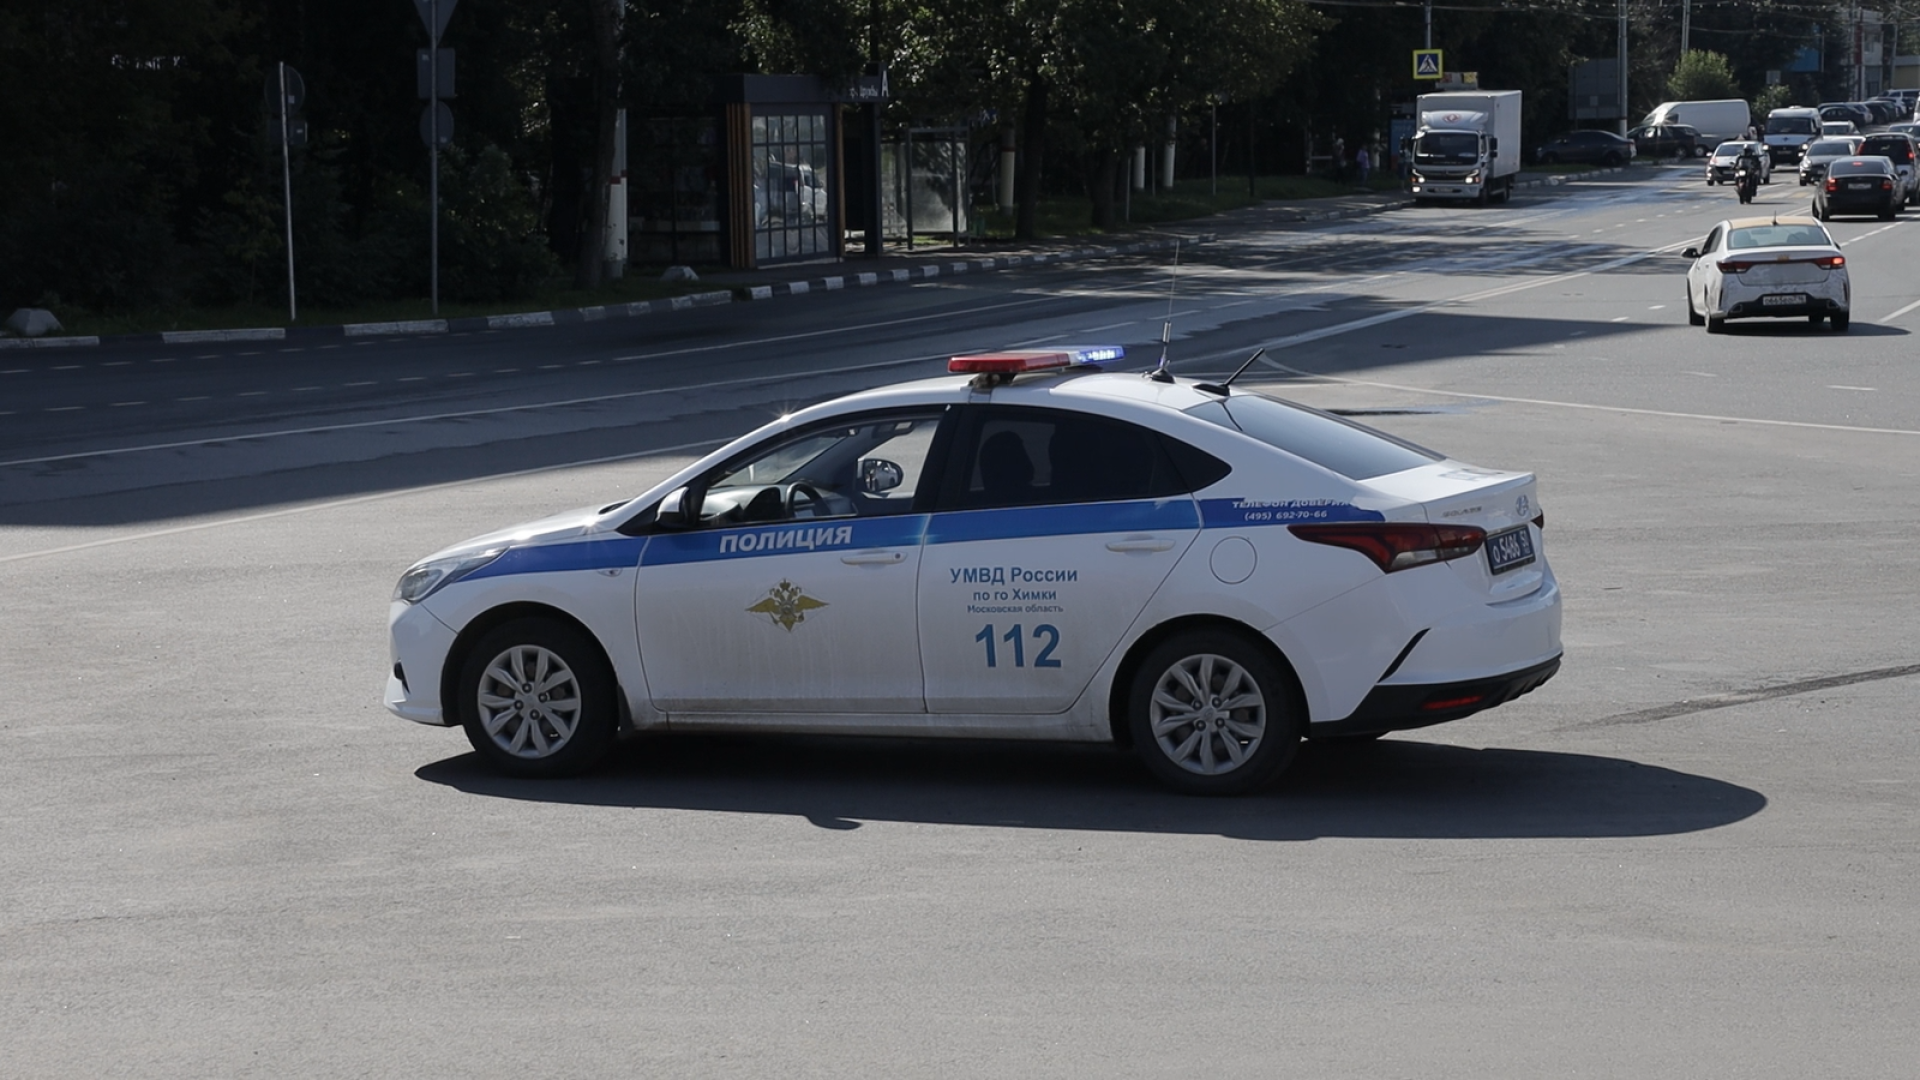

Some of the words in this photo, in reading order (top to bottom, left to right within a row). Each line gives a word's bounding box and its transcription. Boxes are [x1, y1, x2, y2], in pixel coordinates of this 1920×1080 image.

[1244, 511, 1272, 521] (495)
[1276, 510, 1328, 519] 692-70-66
[719, 526, 853, 554] ПОЛИЦИЯ
[950, 567, 1005, 586] УМВД
[1011, 567, 1078, 583] России
[973, 591, 990, 601] по
[994, 591, 1009, 601] го
[1012, 588, 1057, 601] Химки
[967, 604, 1023, 614] Московская
[1025, 603, 1064, 613] область
[975, 623, 1062, 668] 112
